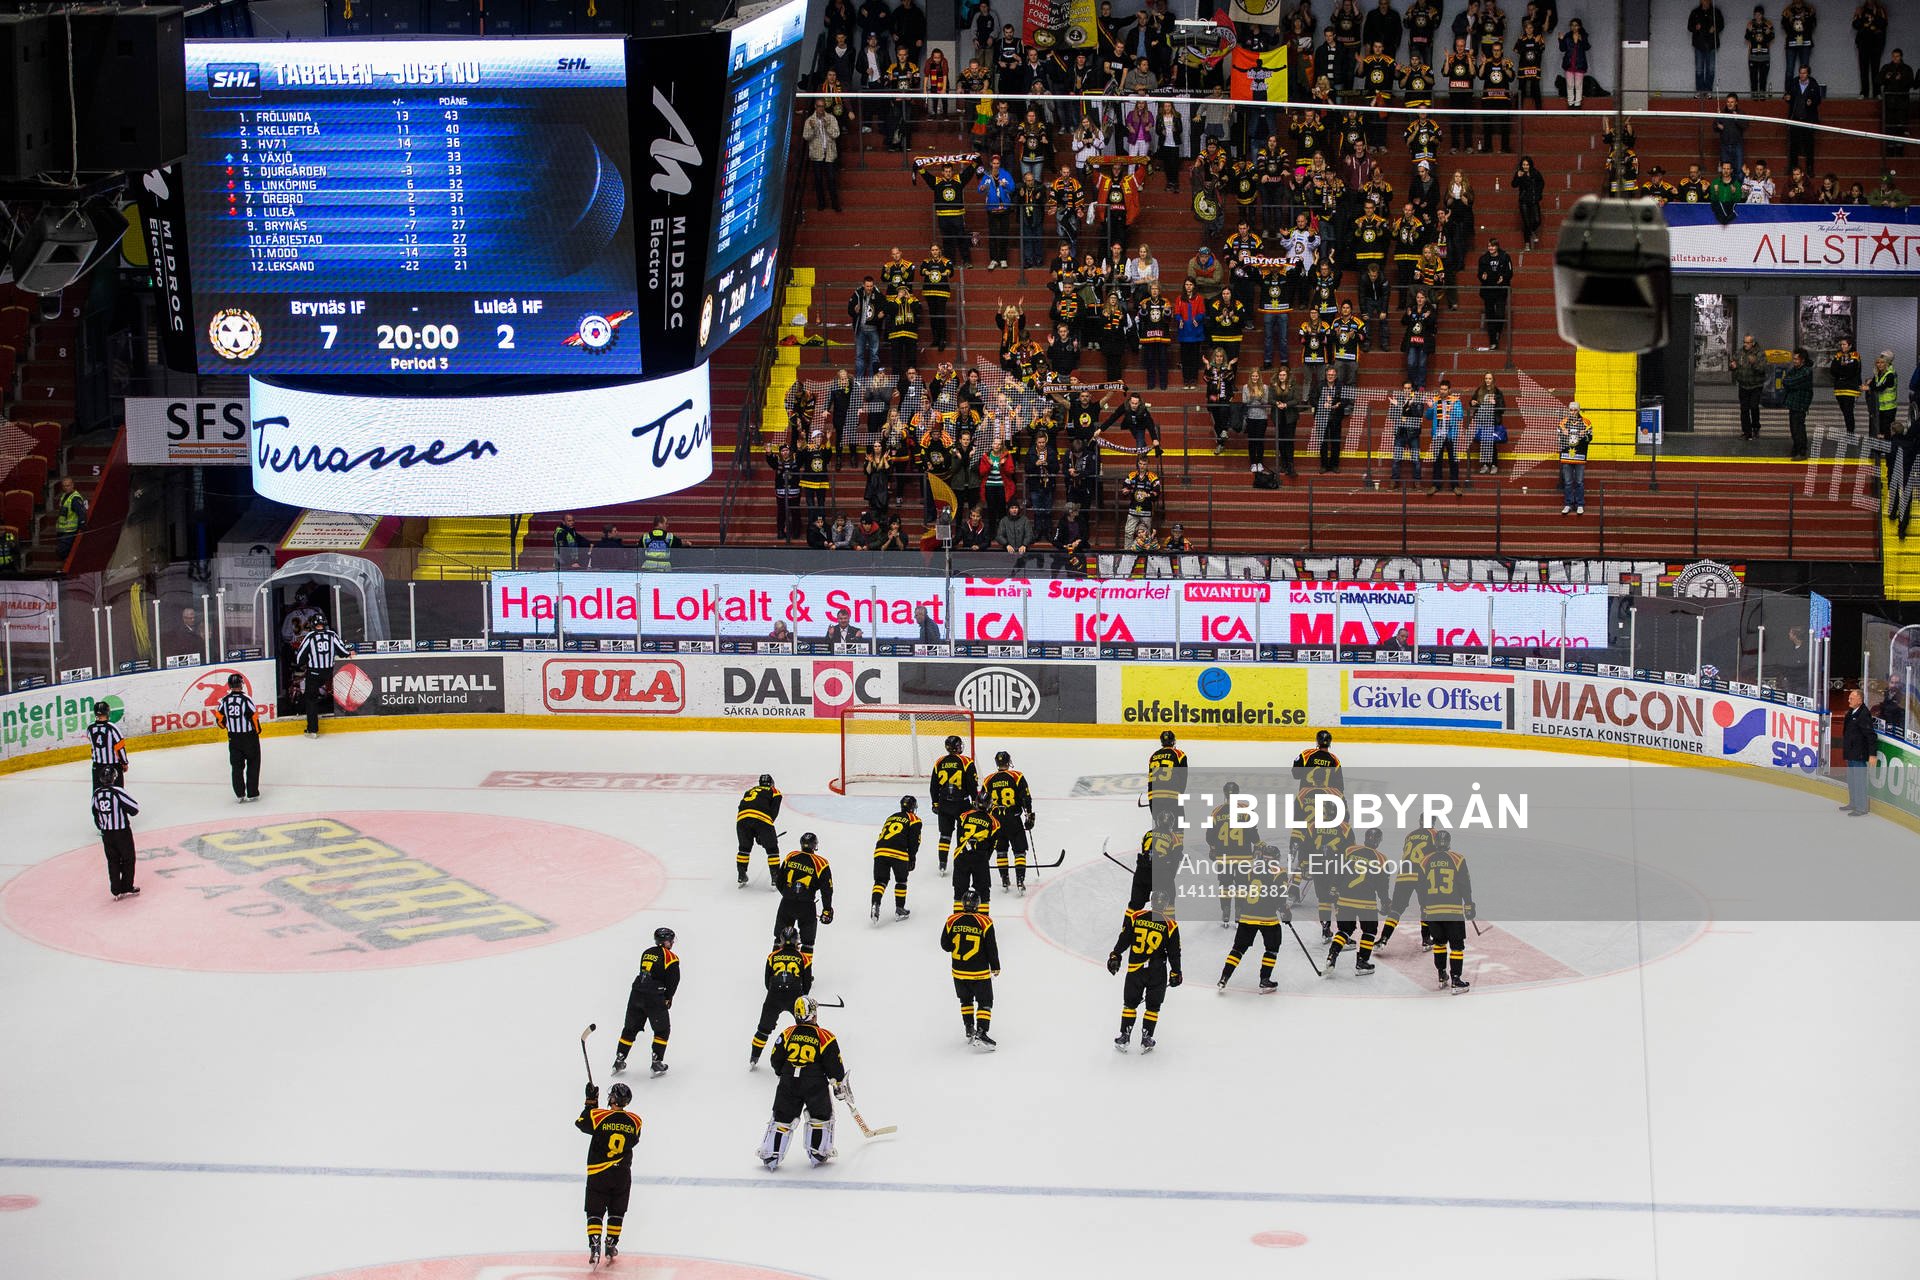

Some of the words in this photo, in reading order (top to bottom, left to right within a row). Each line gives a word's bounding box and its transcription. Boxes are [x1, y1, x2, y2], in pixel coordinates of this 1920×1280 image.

[275, 62, 373, 86] TABELLEN
[393, 61, 447, 85] JUST
[451, 61, 481, 85] NU
[557, 57, 592, 71] SHL
[213, 71, 256, 88] SHL
[256, 110, 312, 122] FRÖLUNDA
[396, 111, 409, 121] 13
[444, 111, 458, 121] 43
[257, 122, 320, 136] SKELLEFTEÅ
[397, 124, 409, 135] 11
[445, 124, 459, 134] 40
[258, 139, 287, 149] HV71
[398, 138, 412, 148] 14
[446, 138, 460, 148] 36
[259, 151, 293, 165] VÄXJÖ
[405, 151, 412, 162] 7
[447, 151, 461, 162] 33
[260, 163, 327, 178] DJURGÅRDEN
[401, 165, 413, 176] -3
[448, 165, 462, 175] 33
[261, 178, 317, 191] LINKÖPING
[407, 179, 414, 189] 6
[449, 179, 463, 189] 32
[262, 192, 304, 204] ÖREBRO
[408, 193, 415, 203] 2
[450, 192, 464, 203] 32
[263, 204, 296, 218] LULEÅ
[408, 206, 416, 217] 5
[451, 206, 464, 216] 31
[264, 218, 307, 231] BRYNÄS
[404, 219, 417, 230] -7
[451, 220, 466, 230] 27
[398, 234, 418, 244] -12
[452, 233, 467, 244] 27
[149, 218, 163, 288] Electro
[399, 247, 419, 258] -14
[453, 247, 468, 257] 23
[649, 218, 664, 290] Electro
[400, 260, 420, 271] -22
[454, 260, 468, 271] 21
[671, 216, 686, 329] MIDROC
[162, 220, 184, 332] MIDROC
[72, 308, 81, 318] 9
[291, 300, 346, 317] Brynäs
[350, 301, 366, 315] IF
[474, 298, 517, 314] Luleå
[522, 300, 543, 314] HF
[320, 325, 338, 350] 7
[376, 324, 459, 350] 20:00
[496, 324, 515, 349] 2
[58, 348, 67, 358] 8
[391, 357, 437, 370] Period
[439, 357, 449, 370] 3
[47, 387, 55, 398] 7
[166, 403, 246, 440] SFS
[252, 415, 499, 473] Terrassen
[92, 466, 101, 476] 5
[997, 581, 1032, 598] nära
[1048, 580, 1171, 602] Supermarket
[1188, 585, 1267, 599] KVANTUM
[1289, 592, 1312, 604] ICA
[1313, 592, 1416, 605] STORMARKNAD
[501, 586, 637, 620] Handla
[653, 588, 773, 622] Lokalt
[785, 590, 814, 622] &
[825, 588, 945, 624] Smart
[965, 612, 1026, 641] ICA
[1075, 613, 1136, 642] ICA
[1201, 615, 1254, 642] ICA
[1290, 613, 1416, 645] MAXI
[317, 640, 330, 652] 90
[1436, 628, 1489, 647] ICA
[1491, 628, 1588, 648] banken
[549, 669, 680, 702] JULA
[723, 666, 881, 706] DALOC
[962, 673, 1033, 713] ARDEX
[382, 693, 415, 705] Södra
[418, 692, 468, 704] Norrland
[1353, 685, 1422, 709] Gävle
[1428, 686, 1503, 713] Offset
[1533, 679, 1704, 737] MACON
[228, 704, 240, 716] 28
[724, 704, 759, 717] SÄKRA
[762, 704, 806, 717] DÖRRAR
[1123, 700, 1307, 725] ekfeltsmaleri.se
[96, 734, 103, 745] 4
[1532, 723, 1595, 740] ELDFASTA
[1598, 729, 1704, 754] KONSTRUKTIONER
[1313, 758, 1331, 767] SCOTT
[1772, 742, 1819, 774] SPO
[938, 770, 963, 790] 24
[1148, 760, 1175, 782] 23
[492, 772, 738, 791] Scandic
[100, 800, 112, 812] 82
[991, 788, 1016, 808] 18
[1217, 821, 1244, 847] 44
[190, 818, 552, 948] SPORT
[1426, 868, 1455, 895] 13
[951, 934, 981, 961] 17
[1131, 927, 1163, 954] 39
[786, 1042, 817, 1063] 29
[607, 1133, 625, 1158] 9
